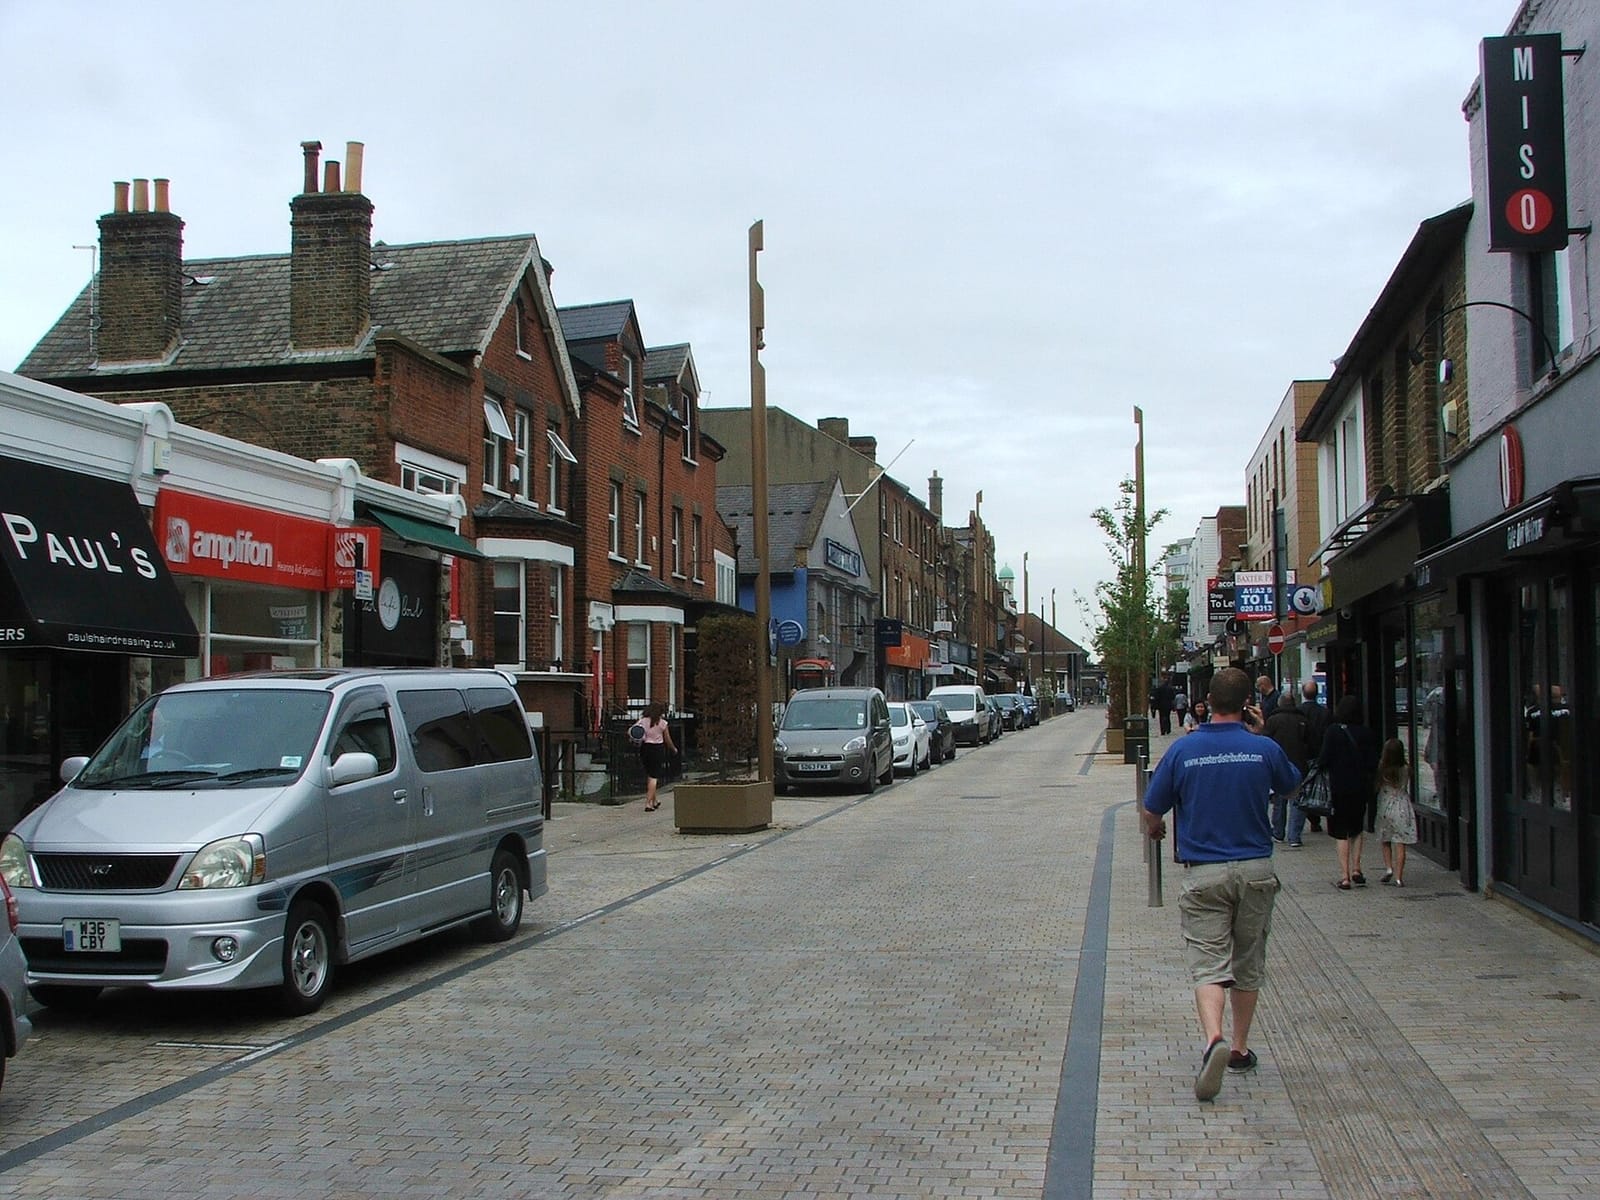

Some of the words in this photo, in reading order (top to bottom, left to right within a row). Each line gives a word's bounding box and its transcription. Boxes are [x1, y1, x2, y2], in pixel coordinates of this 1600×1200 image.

[1513, 46, 1537, 230] MISO
[192, 529, 273, 569] amplifon
[1210, 600, 1221, 608] To
[1241, 594, 1260, 605] TO
[67, 632, 177, 649] paulshairdressing.co.uk
[80, 935, 106, 949] CBY
